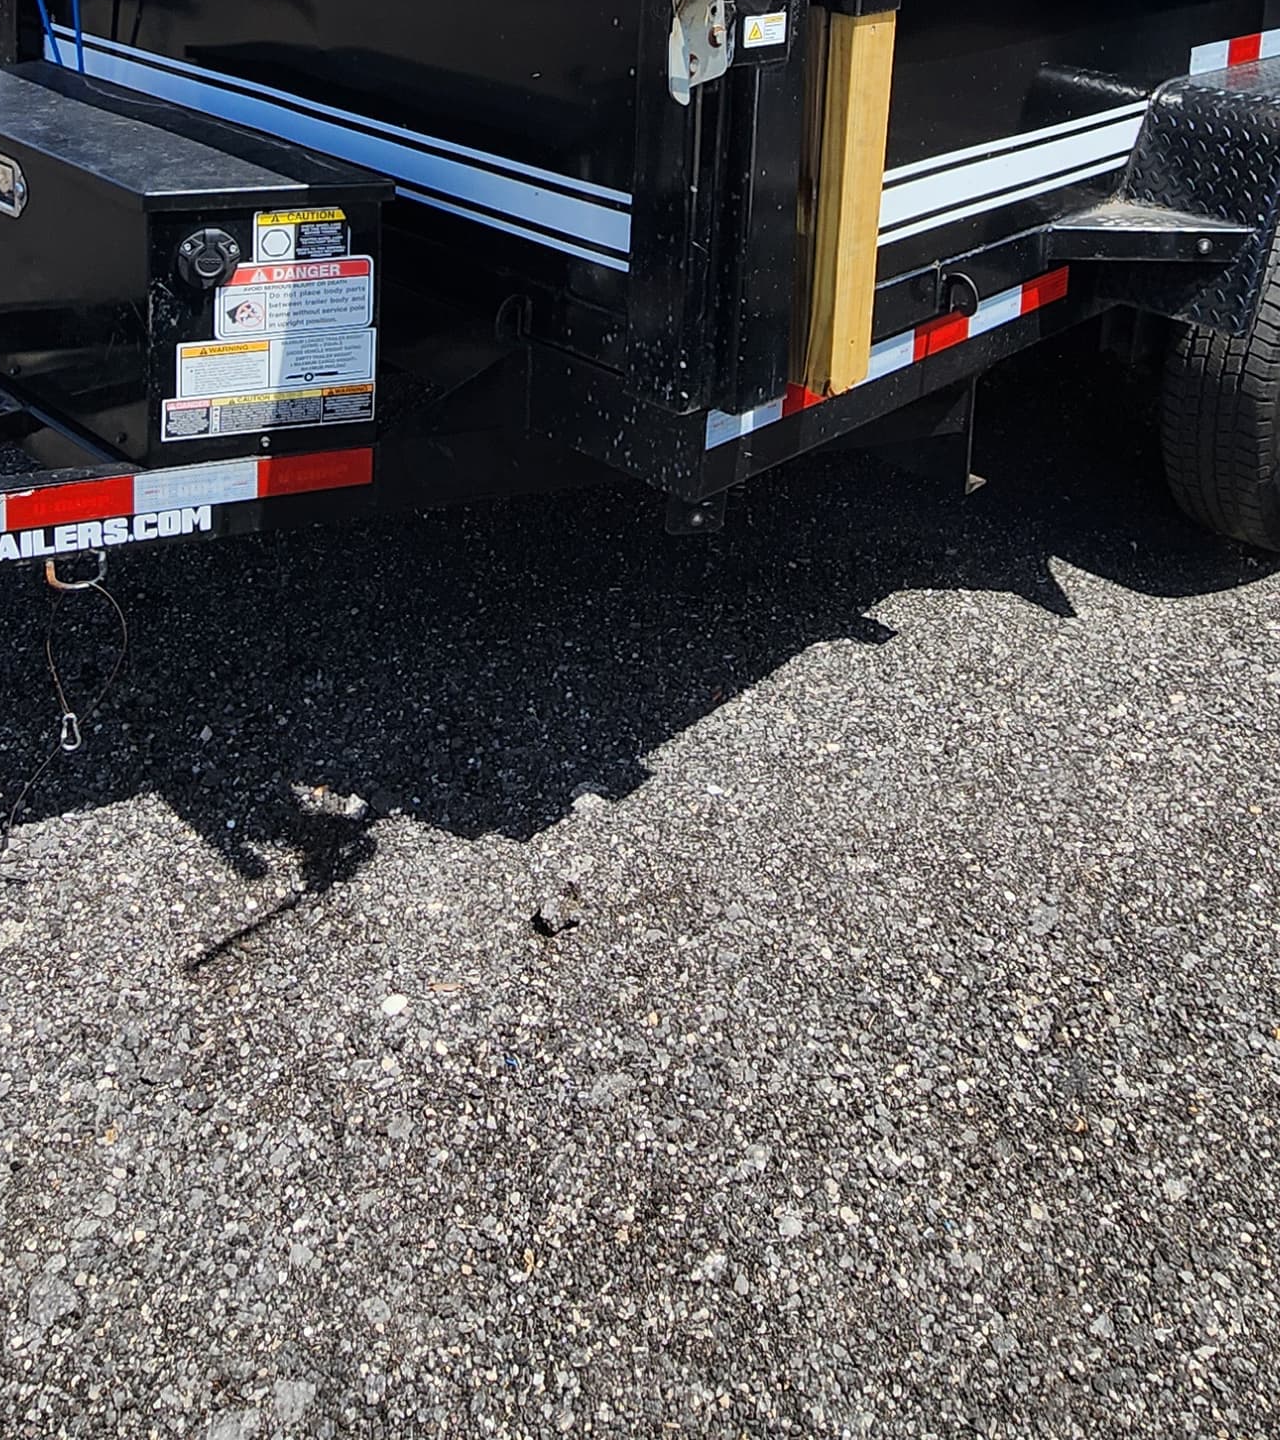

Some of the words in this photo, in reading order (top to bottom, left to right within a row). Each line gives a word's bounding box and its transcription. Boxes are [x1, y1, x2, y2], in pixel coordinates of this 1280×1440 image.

[287, 211, 335, 220] CAUTION
[273, 263, 340, 281] DANGER
[283, 290, 297, 298] not
[299, 289, 321, 297] place
[323, 287, 343, 295] body
[345, 286, 366, 294] parts
[269, 301, 302, 309] between
[329, 296, 349, 304] body
[292, 308, 320, 316] without
[208, 344, 249, 353] WARNING
[237, 395, 270, 404] CAUTION
